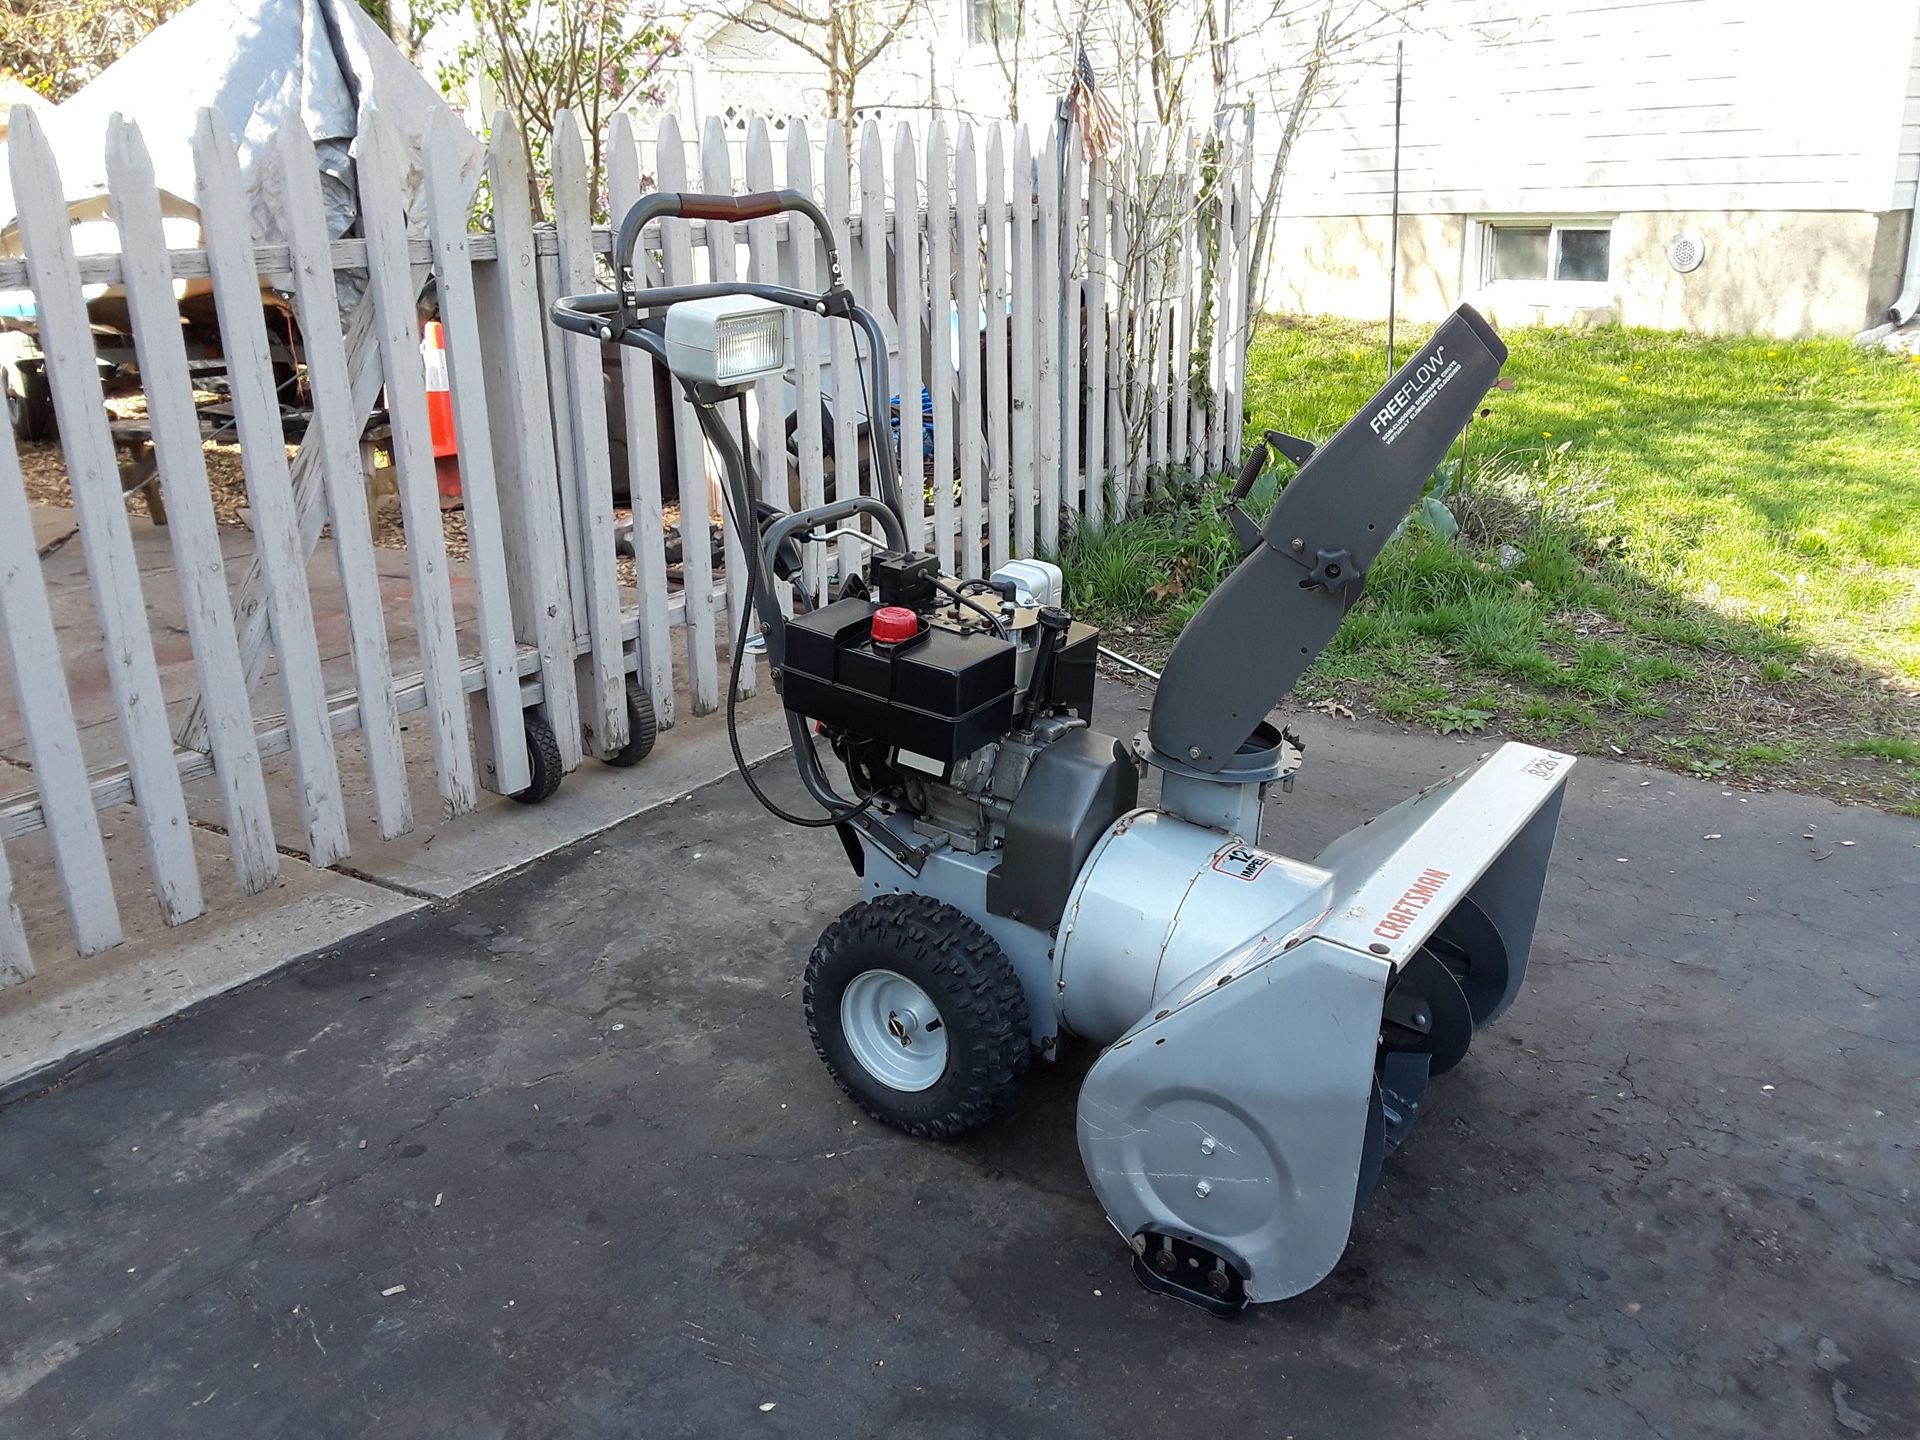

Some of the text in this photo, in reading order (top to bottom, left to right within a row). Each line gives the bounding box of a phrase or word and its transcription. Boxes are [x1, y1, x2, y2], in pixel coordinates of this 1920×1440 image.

[1382, 360, 1458, 441] NON-CLOGGING DISCHARGE CHUTE
[1386, 363, 1462, 445] VIRTUALLY ELIMINATES CLOGGING
[1373, 867, 1451, 940] CRAFTSMAN
